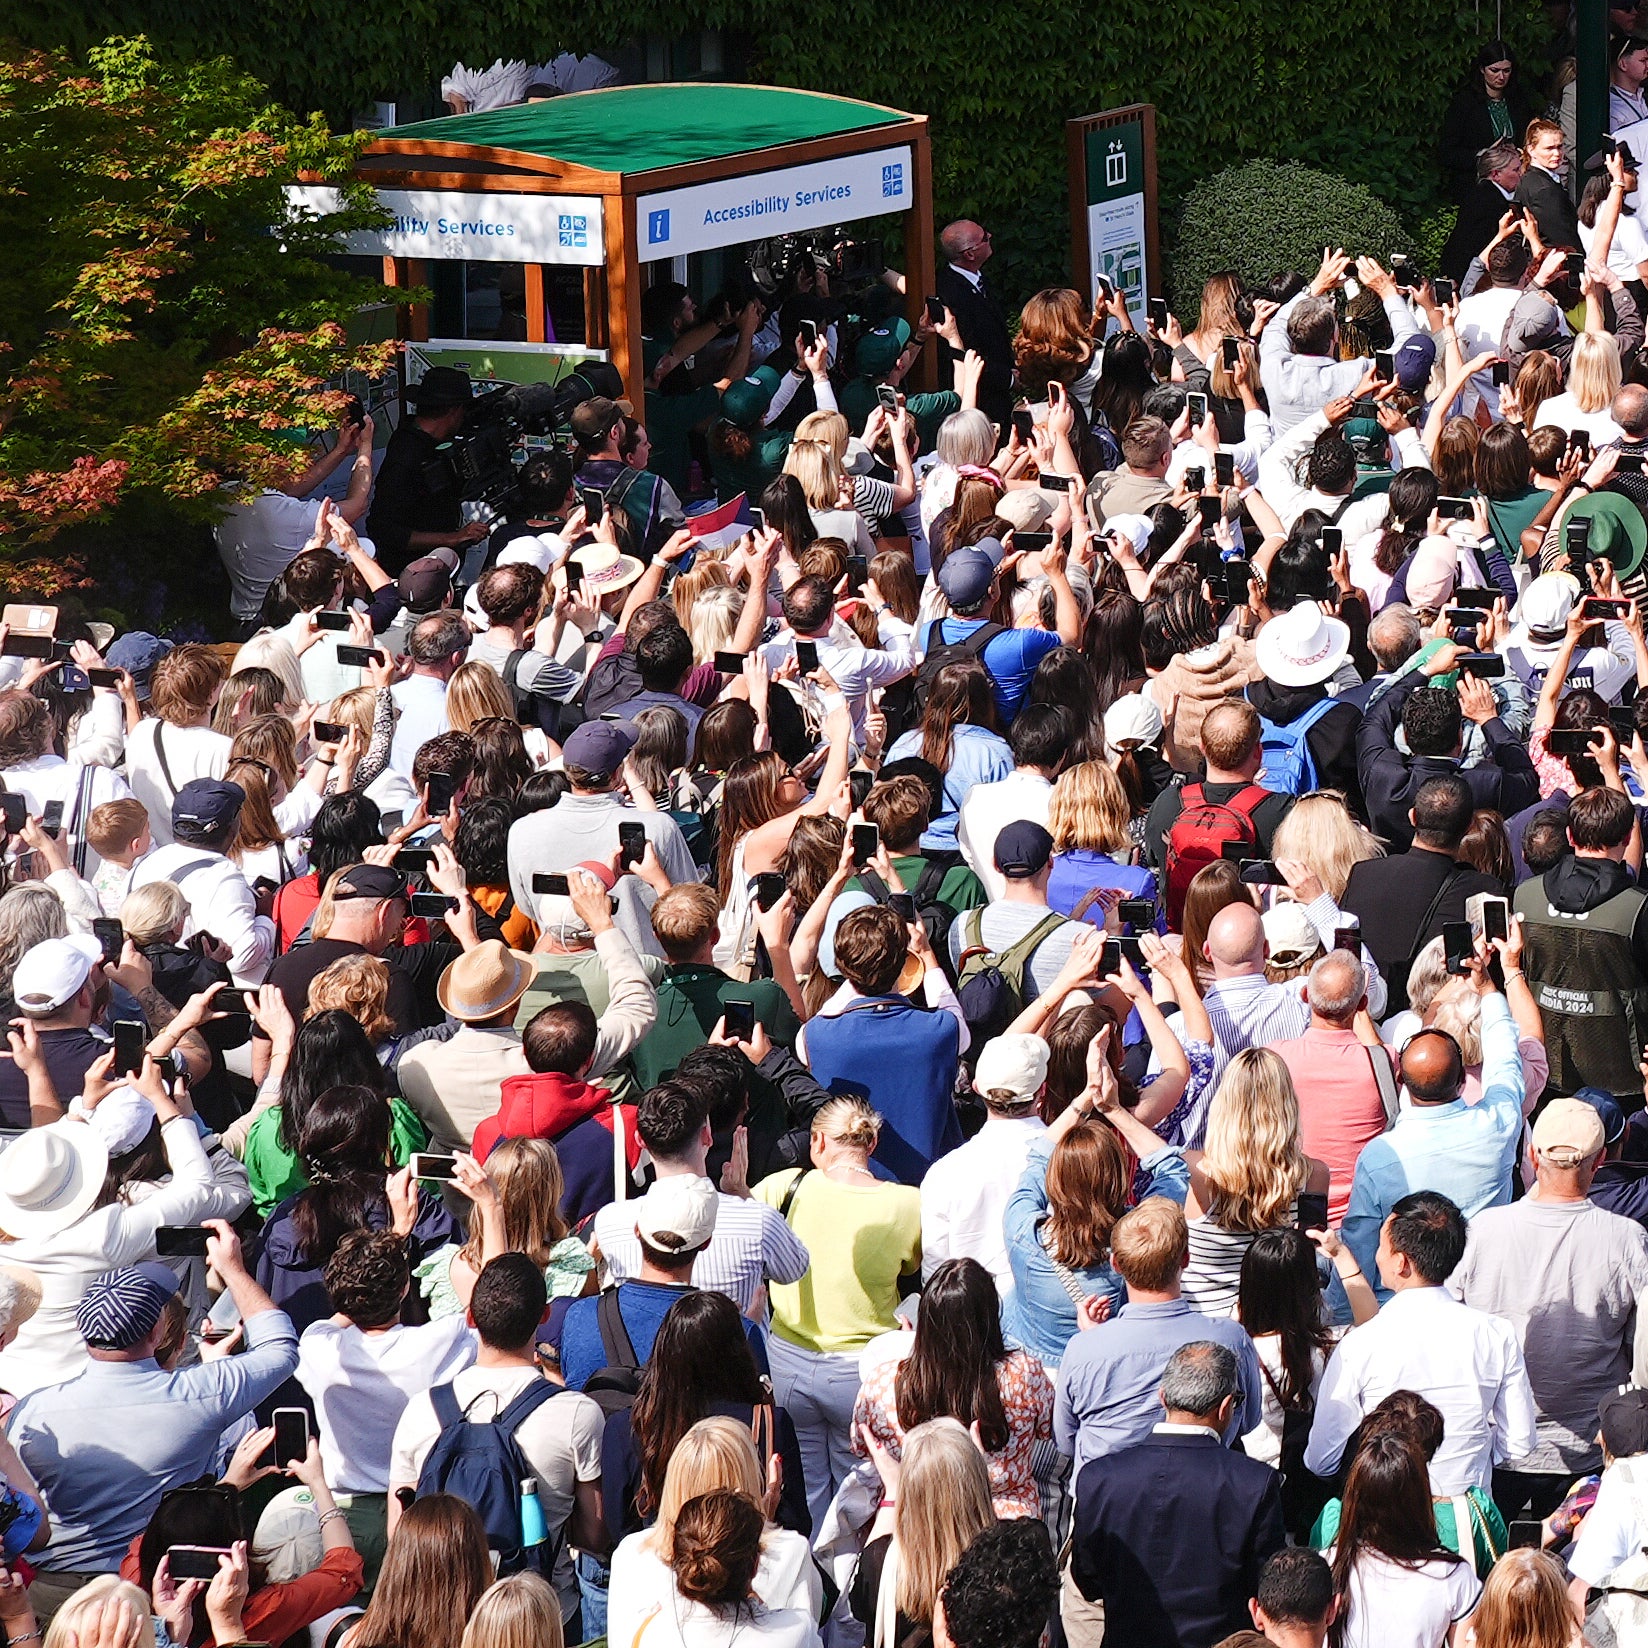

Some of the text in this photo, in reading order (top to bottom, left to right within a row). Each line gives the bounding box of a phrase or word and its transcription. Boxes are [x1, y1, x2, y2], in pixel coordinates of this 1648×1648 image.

[703, 184, 852, 226] Accessibility Services
[437, 218, 514, 237] Services
[1539, 993, 1594, 1014] MEDIA 2024
[1558, 990, 1589, 1002] OFFICIAL
